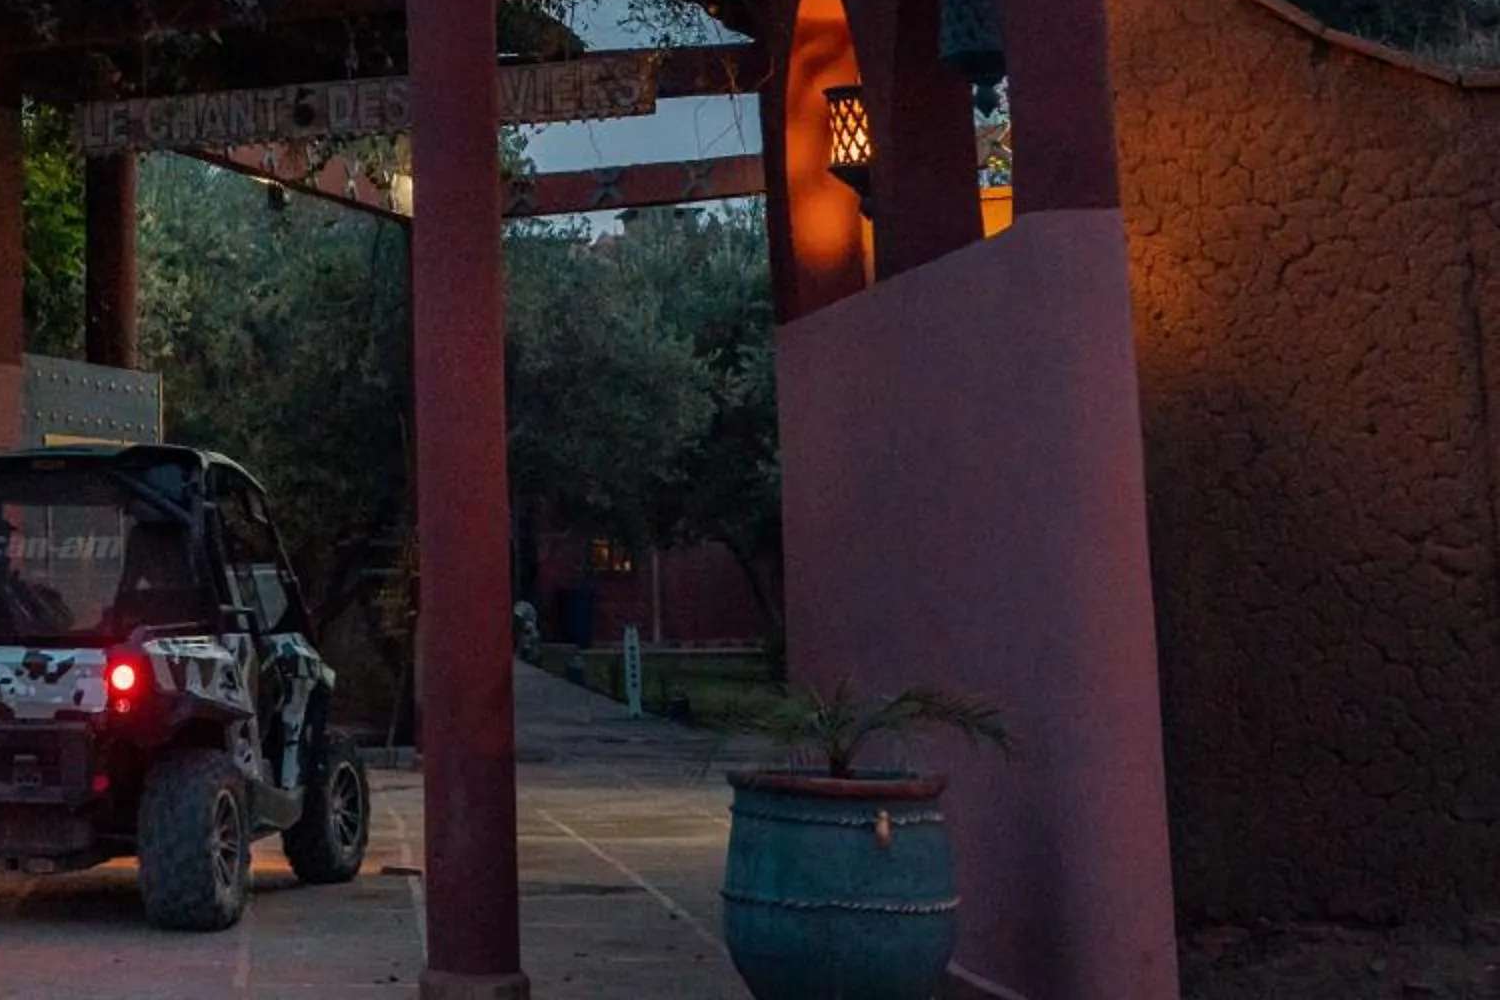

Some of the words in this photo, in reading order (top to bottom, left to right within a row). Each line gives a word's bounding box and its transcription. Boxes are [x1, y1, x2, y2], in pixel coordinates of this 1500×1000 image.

[83, 101, 129, 146] LE
[327, 79, 409, 131] DES
[498, 58, 641, 115] VIERS
